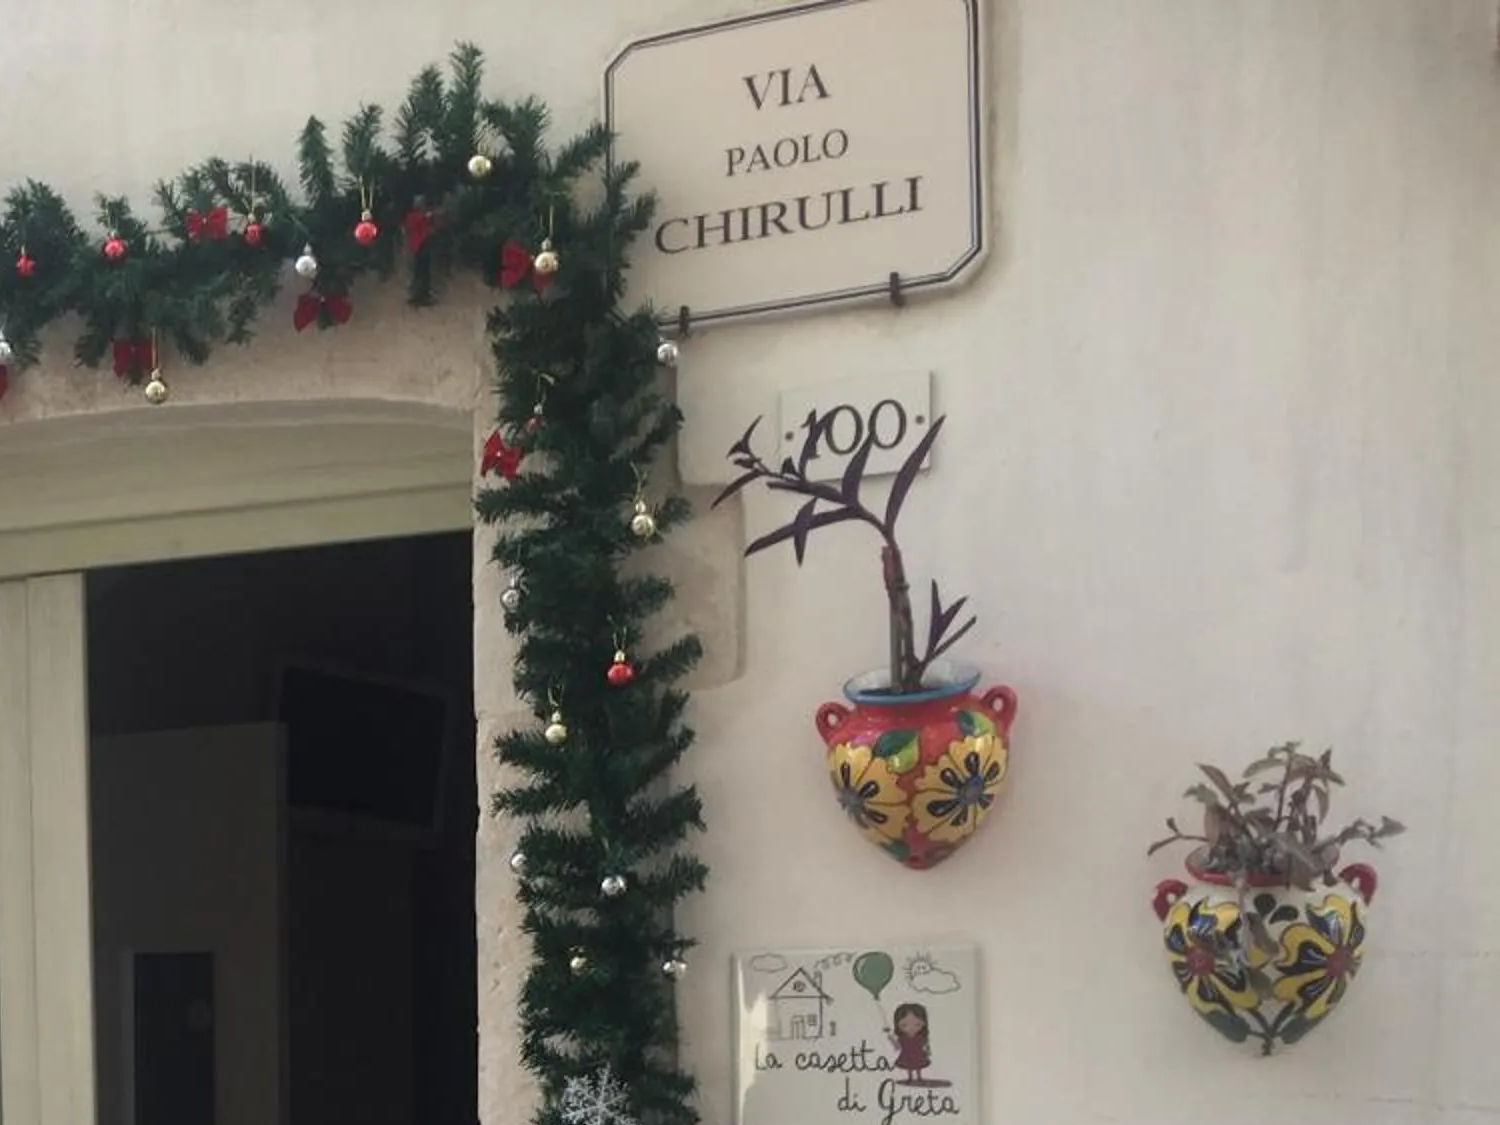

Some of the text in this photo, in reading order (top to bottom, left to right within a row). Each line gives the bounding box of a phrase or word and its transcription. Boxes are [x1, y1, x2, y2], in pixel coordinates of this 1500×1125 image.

[743, 63, 832, 111] VIA
[725, 128, 849, 177] PAOLO
[654, 176, 924, 255] CHIRULLI
[795, 1039, 895, 1073] casetta
[837, 1077, 866, 1113] di
